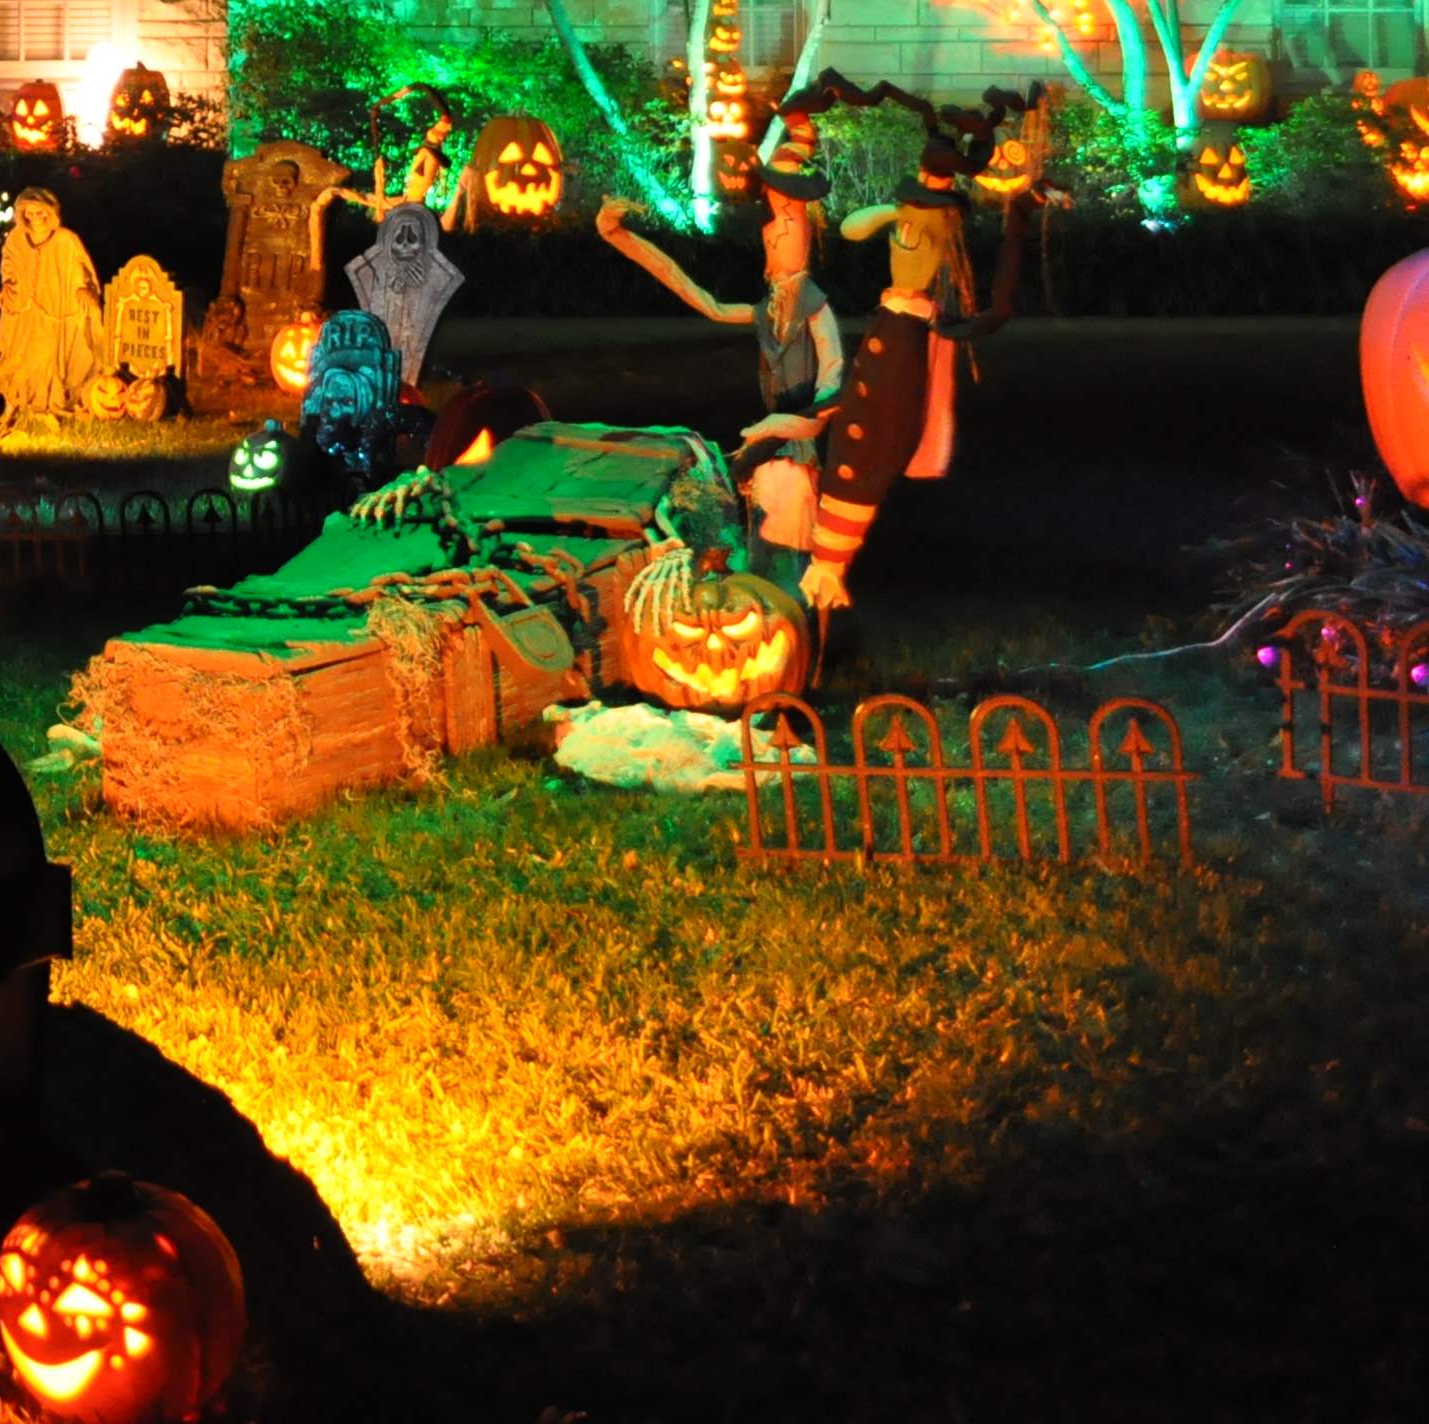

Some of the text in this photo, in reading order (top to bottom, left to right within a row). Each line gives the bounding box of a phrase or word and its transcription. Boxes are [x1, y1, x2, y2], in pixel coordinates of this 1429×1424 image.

[128, 308, 160, 324] REST
[137, 326, 150, 341] IN
[122, 342, 166, 360] PIECES
